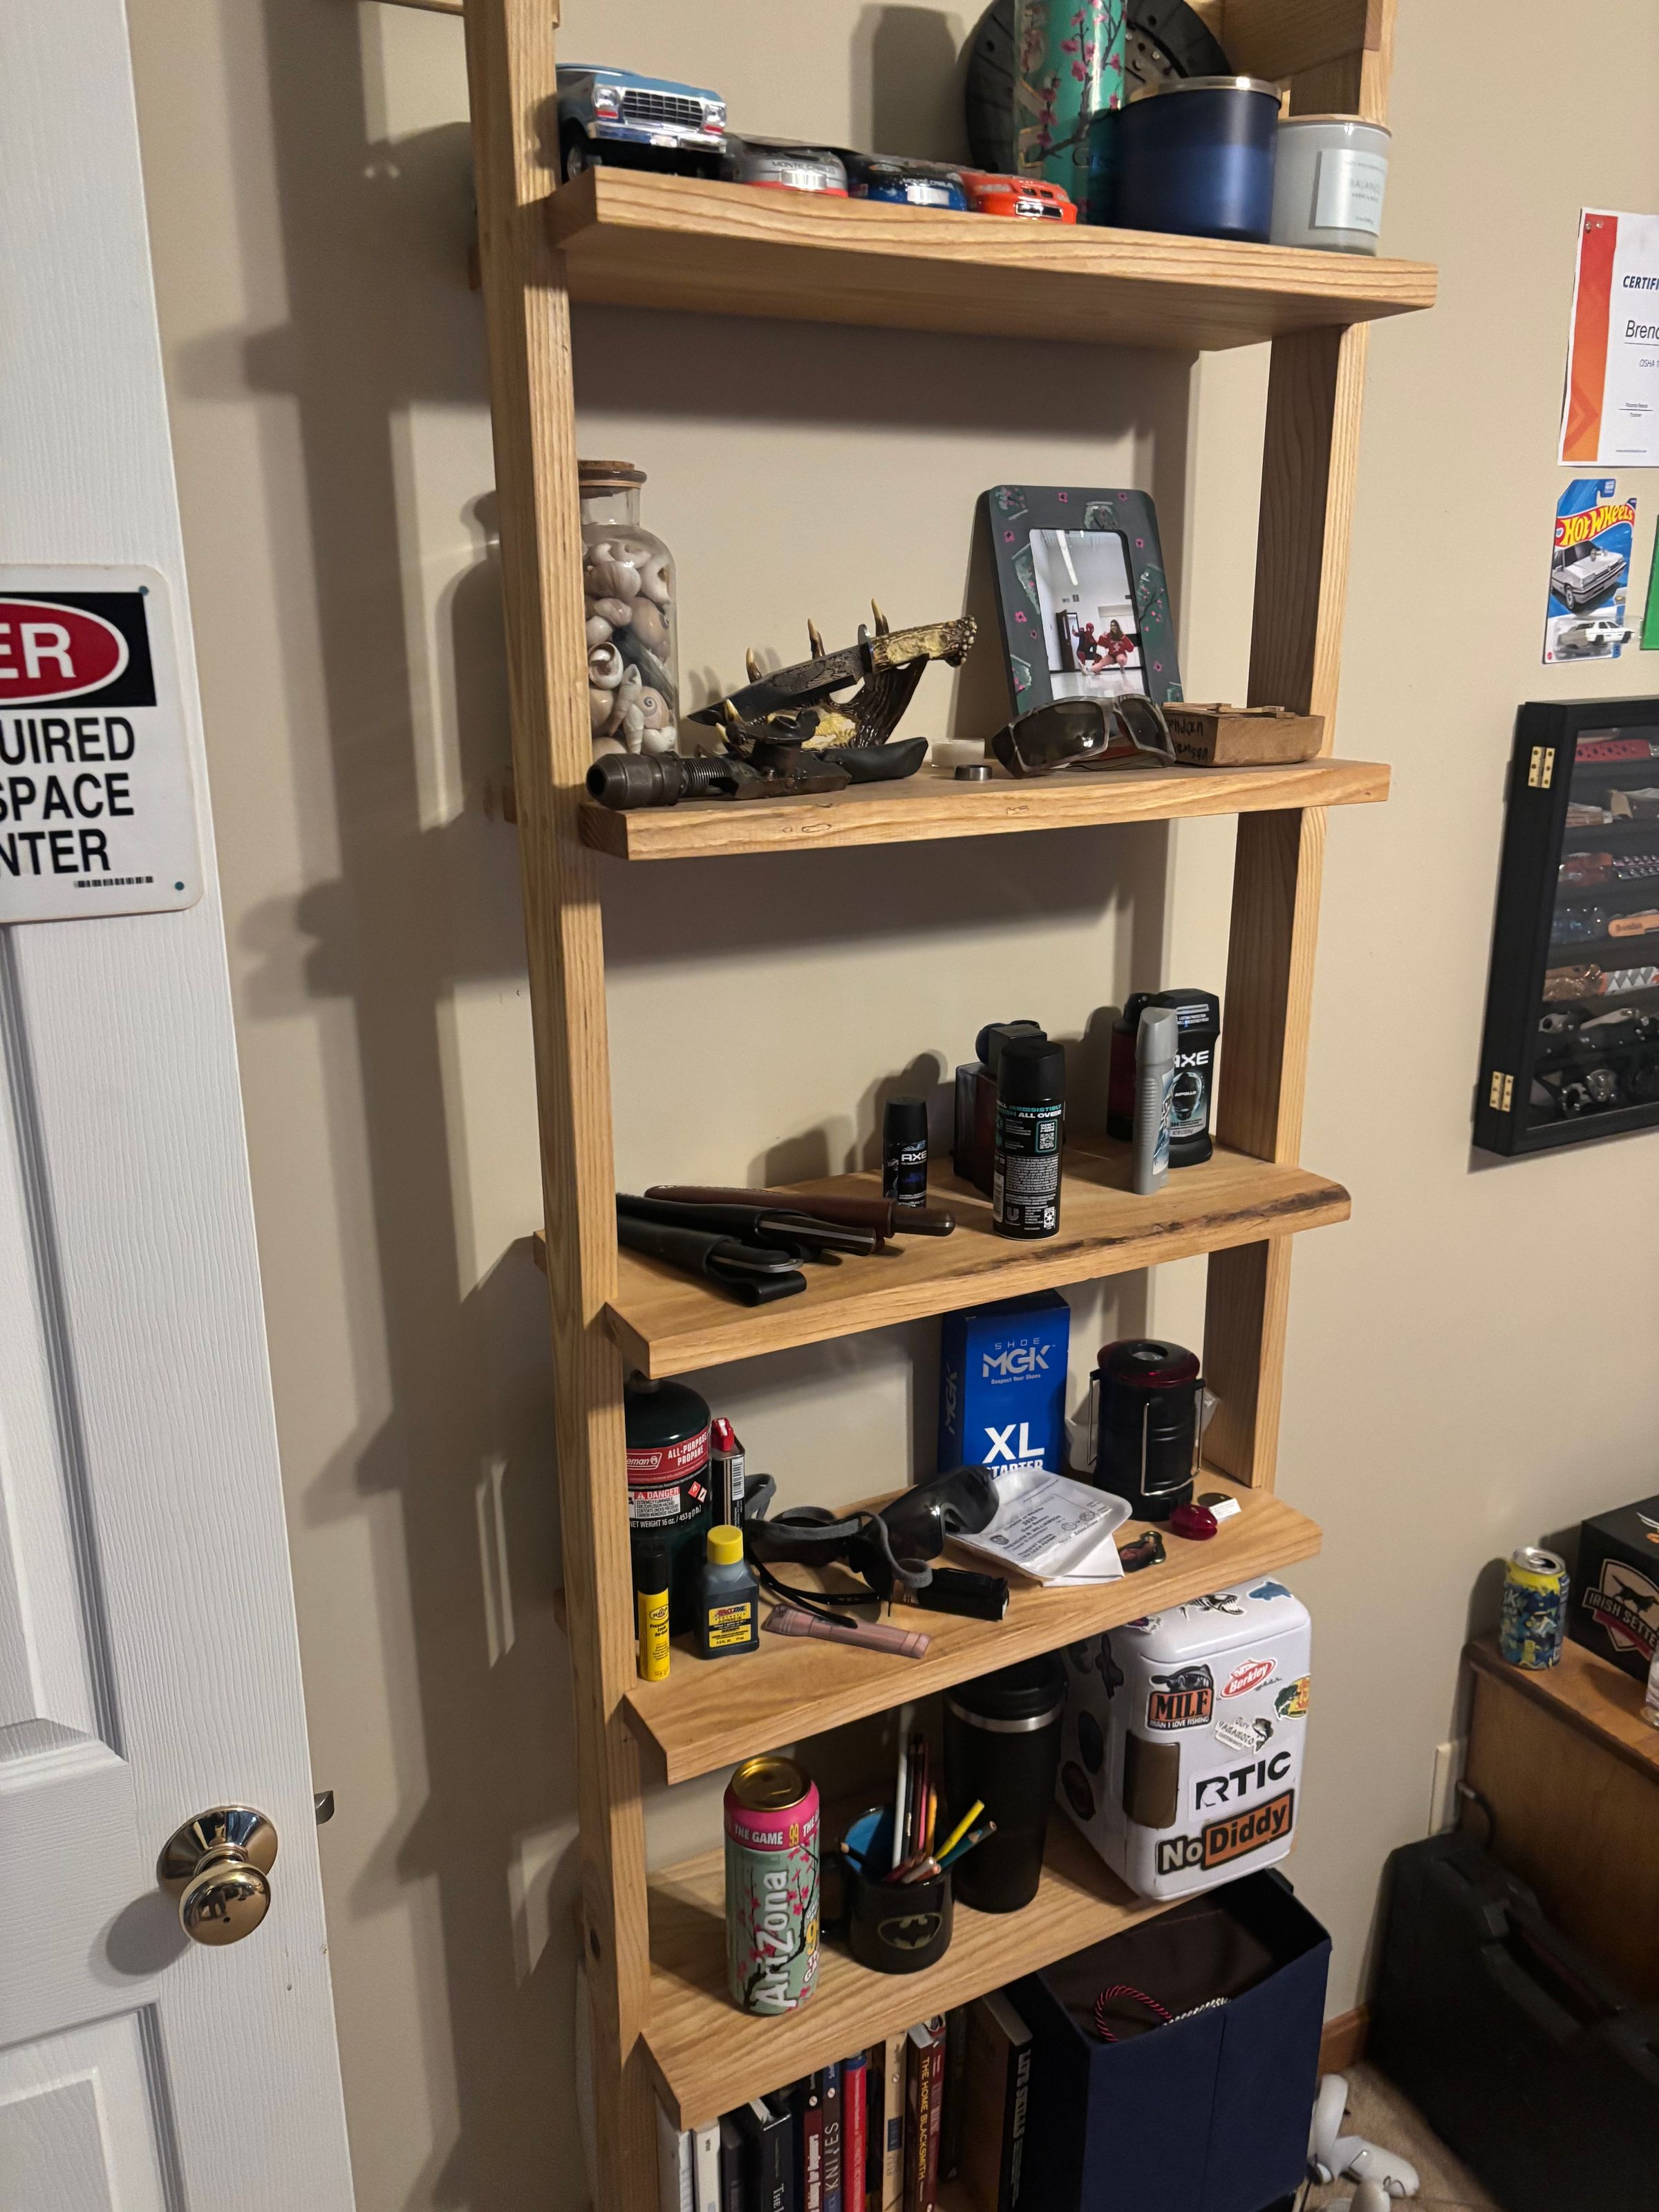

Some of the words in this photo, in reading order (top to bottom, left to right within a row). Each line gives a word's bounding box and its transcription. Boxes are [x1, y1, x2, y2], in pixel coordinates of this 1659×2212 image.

[1174, 1050, 1210, 1068] AXE
[1037, 1109, 1062, 1118] OVER
[901, 1150, 927, 1161] AXE
[995, 1338, 1040, 1350] SHOE
[982, 1345, 1051, 1378] MGK
[668, 1432, 707, 1459] ALL-PURPOSE
[677, 1445, 704, 1466] PROPANE
[982, 1423, 1045, 1464] XL
[647, 1486, 679, 1499] DANGER
[640, 1519, 661, 1528] WEIGHT
[679, 1512, 688, 1521] 453
[1589, 1593, 1622, 1617] IRISH
[1229, 1663, 1268, 1694] Berkley
[1155, 1691, 1208, 1720] MILF
[1172, 1719, 1186, 1728] LOVE
[1187, 1716, 1210, 1725] FISHING
[1195, 1751, 1291, 1810] RTIC
[734, 1823, 750, 1840] THE
[751, 1831, 784, 1845] GAME
[803, 1815, 815, 1837] THE
[1162, 1840, 1203, 1871] No
[1210, 1804, 1287, 1856] Diddy
[750, 1870, 799, 2012] AriZona
[921, 2056, 930, 2079] THE
[920, 2080, 930, 2113] HOME
[918, 2113, 928, 2181] BLACKSMITH
